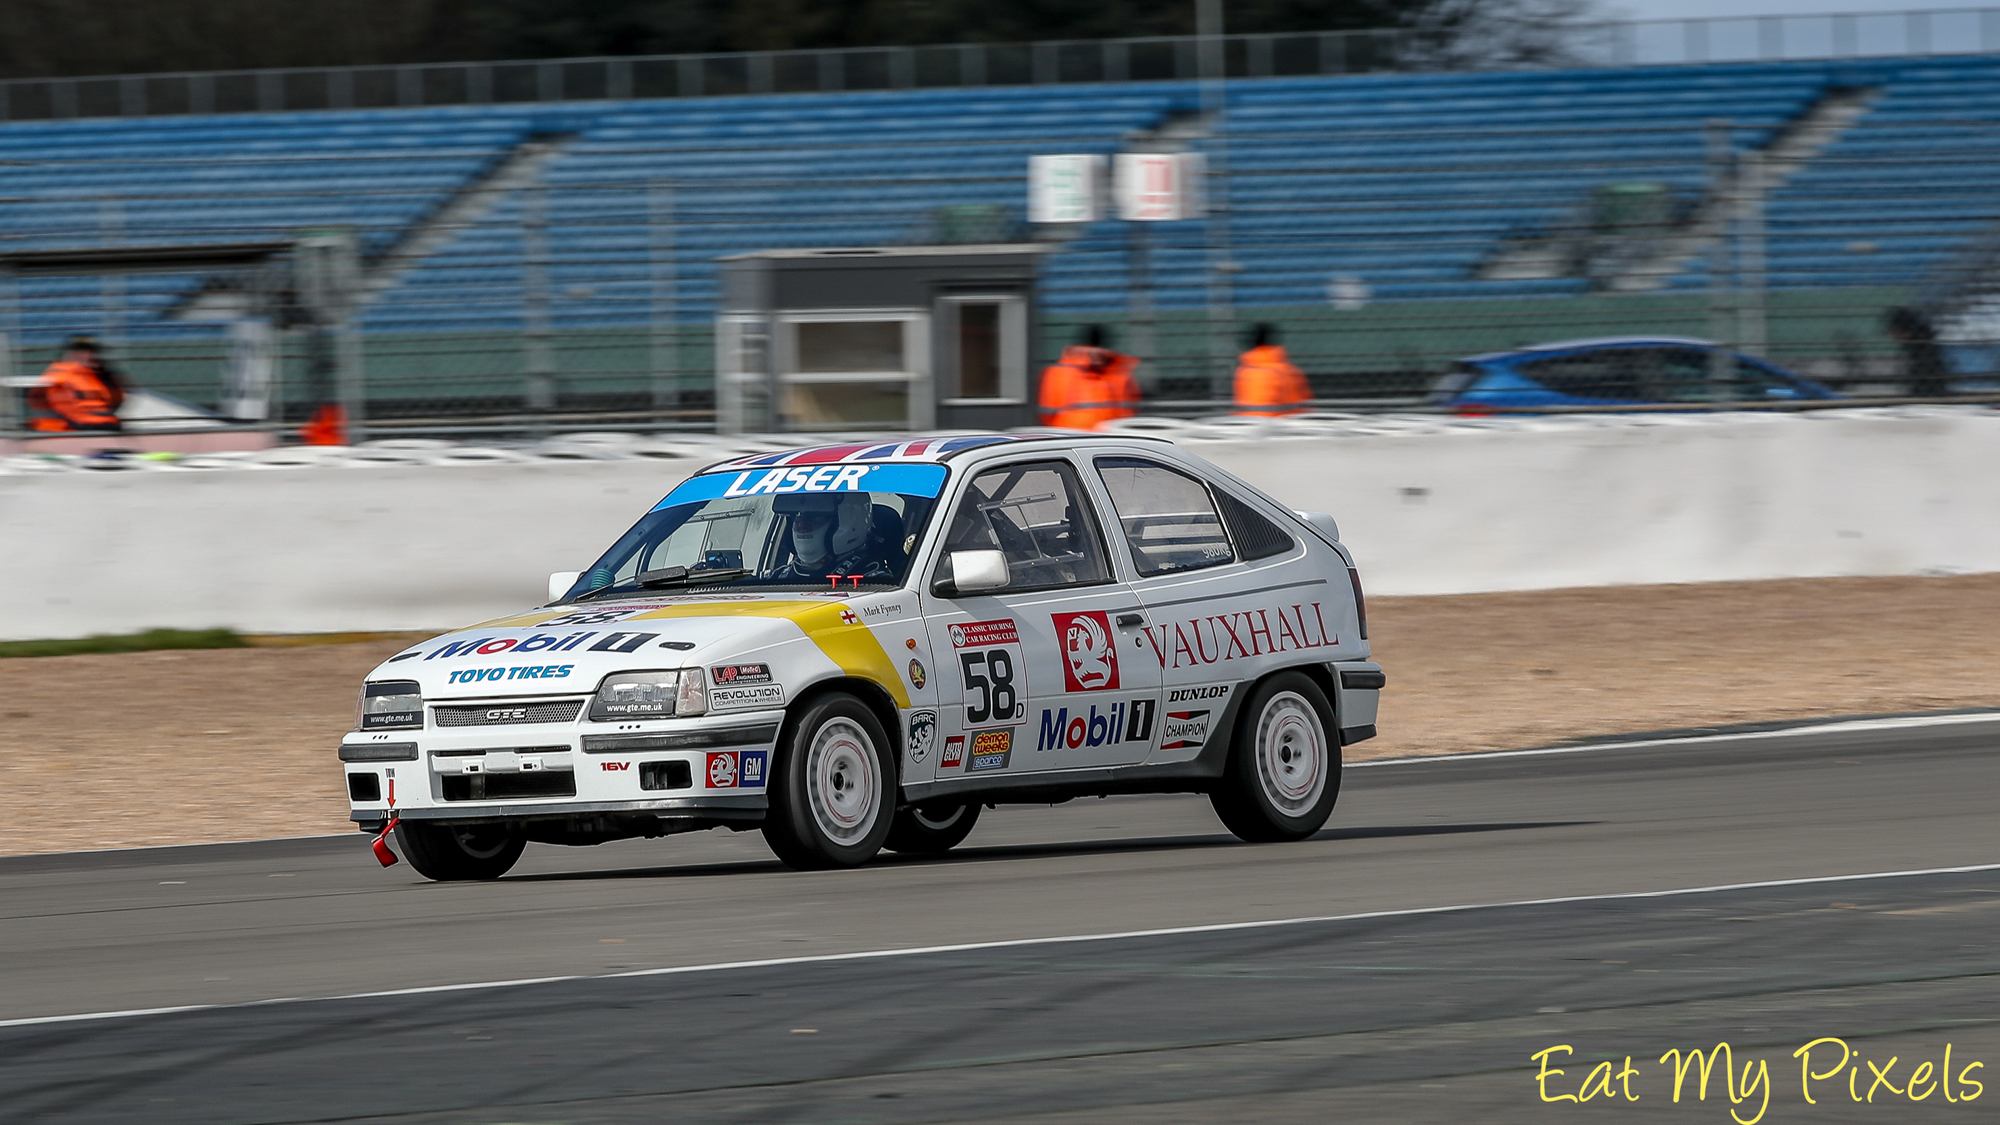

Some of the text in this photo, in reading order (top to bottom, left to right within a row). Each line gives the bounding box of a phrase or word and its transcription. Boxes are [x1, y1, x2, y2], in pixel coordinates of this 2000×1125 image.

[723, 465, 871, 498] LASER
[862, 605, 881, 617] Mark
[962, 622, 1014, 634] CLASSIC TOURING
[966, 631, 1018, 644] CAR RACING CLUB
[1141, 602, 1340, 670] VAUXHALL
[423, 632, 600, 661] Mobil
[448, 664, 575, 684] TOYO TIRES
[713, 666, 738, 682] LAP
[736, 673, 769, 681] ENGINEERING
[960, 649, 1025, 723] 58 D
[713, 687, 780, 701] REVOLUTION
[1168, 685, 1229, 703] DUNLOP
[606, 703, 663, 713] www.gte.me.uk
[714, 698, 754, 707] COMPETITION
[370, 713, 414, 724] www.gte.me.uk
[486, 708, 527, 720] GTE
[912, 713, 935, 726] BARC
[1037, 702, 1125, 751] Mobil
[1165, 722, 1207, 738] CHAMPION
[976, 731, 1009, 745] demon
[946, 742, 963, 752] AUTO
[972, 742, 1009, 755] tweeks
[600, 761, 631, 772] 16V
[744, 757, 762, 776] GM
[975, 755, 1002, 766] sparco
[385, 767, 396, 778] TOW
